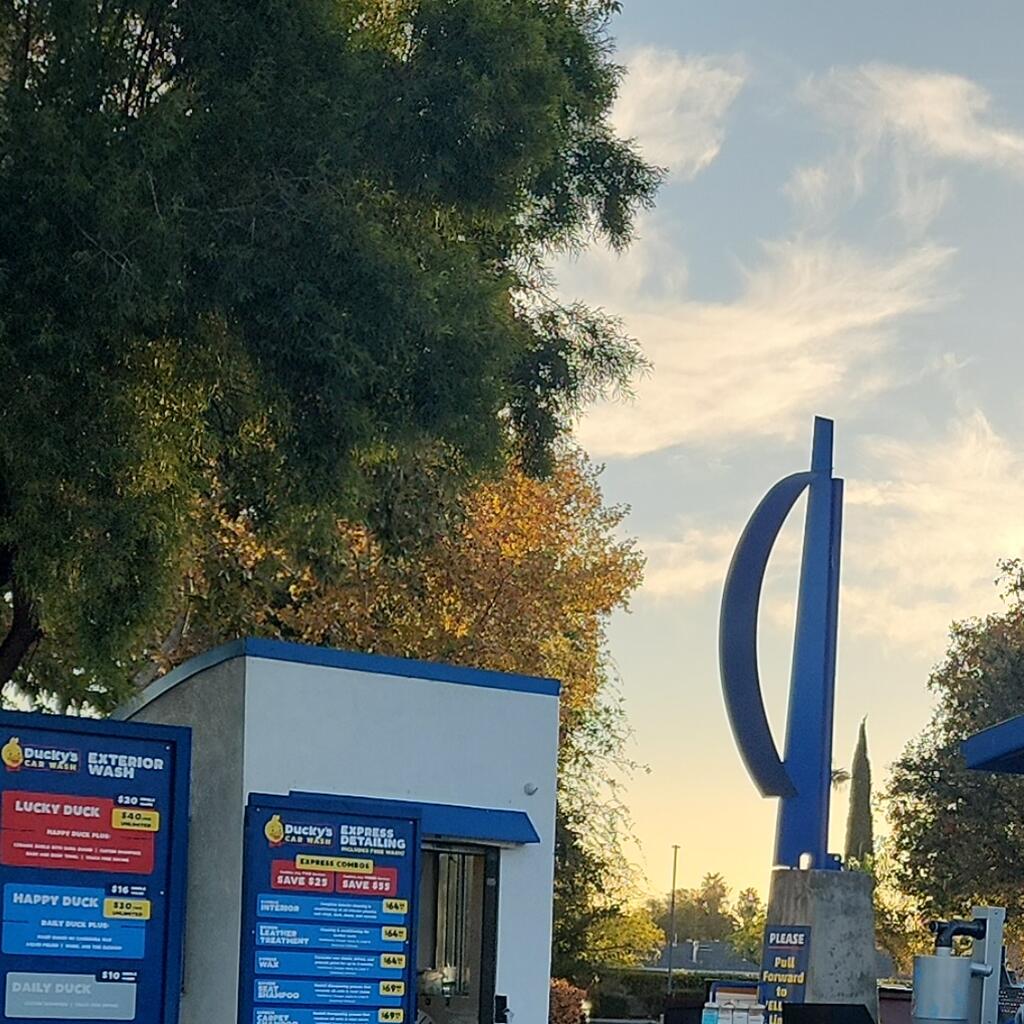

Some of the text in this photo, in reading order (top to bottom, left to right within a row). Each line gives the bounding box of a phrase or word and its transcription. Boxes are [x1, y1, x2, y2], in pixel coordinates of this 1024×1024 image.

[24, 748, 78, 762] Ducky's
[88, 752, 164, 770] EXTERIOR
[24, 760, 77, 771] CAR WASH
[88, 764, 135, 779] WASH
[118, 795, 138, 805] $20
[15, 800, 100, 817] LUCKY DUCK
[121, 812, 142, 820] $40
[284, 824, 333, 838] Ducky's
[340, 825, 394, 838] EXPRESS
[306, 837, 332, 845] WASH
[340, 836, 406, 849] DETAILING
[300, 858, 370, 869] EXPRESS COMBOS
[277, 875, 328, 887] SAVE $25
[342, 880, 369, 889] SAVE
[111, 884, 130, 894] $16
[13, 892, 99, 908] HAPPY DUCK
[769, 933, 805, 944] PLEASE
[774, 956, 796, 968] Pull
[102, 971, 120, 980] $10
[763, 971, 805, 984] Forward
[12, 982, 92, 994] DAILY DUCK
[776, 986, 788, 997] to
